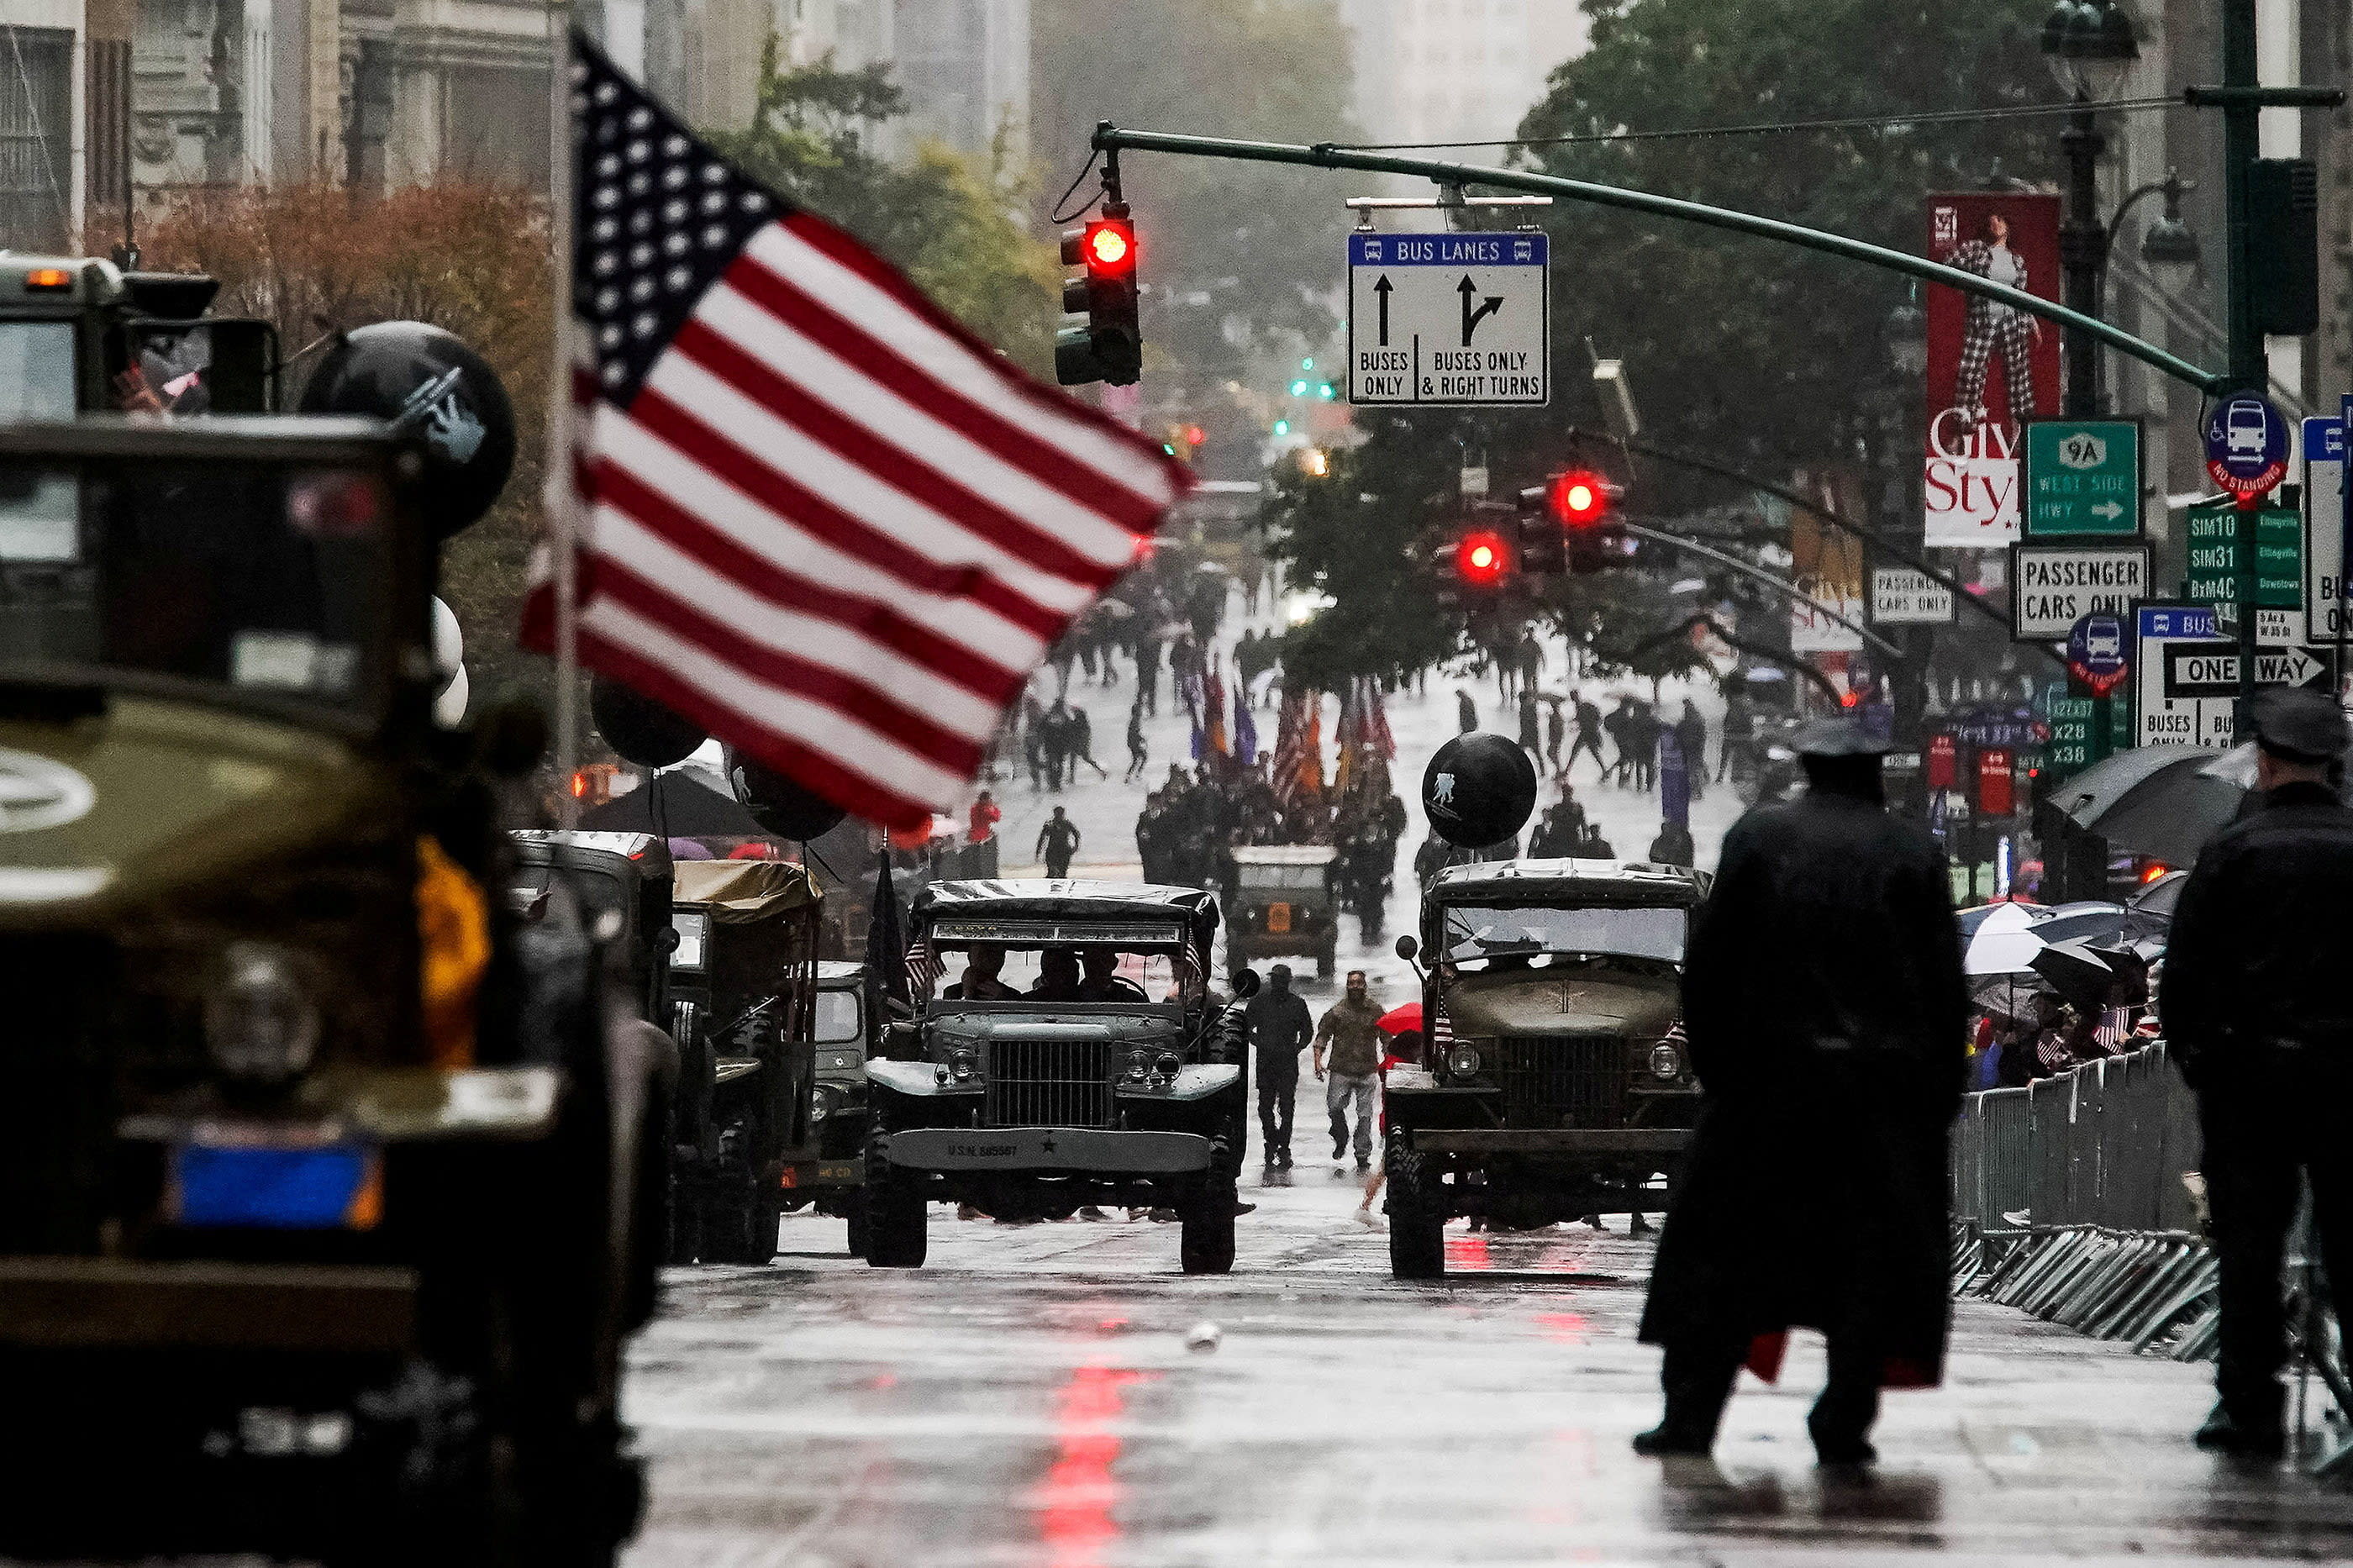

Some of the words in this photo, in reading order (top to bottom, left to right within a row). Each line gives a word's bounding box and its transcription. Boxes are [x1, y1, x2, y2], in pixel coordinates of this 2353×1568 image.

[1398, 242, 1433, 260] BUS
[1442, 242, 1500, 260] LANES
[1361, 352, 1408, 371] BUSES
[1434, 352, 1481, 371] BUSES
[1487, 352, 1527, 371] ONLY
[1365, 376, 1403, 395] ONLY
[1422, 376, 1434, 395] &
[1441, 376, 1487, 395] RIGHT
[1491, 376, 1539, 395] TURNS
[1930, 406, 2021, 462] Giv
[2068, 441, 2098, 461] 9A
[2040, 476, 2080, 492] WEST
[2092, 475, 2124, 492] SIDE
[2214, 463, 2229, 481] NO
[2229, 463, 2281, 492] STANDING
[1926, 460, 2020, 528] Sty
[2039, 502, 2073, 518] HWY
[2191, 514, 2235, 537] SIM10
[2192, 545, 2234, 568] SIM31
[1878, 576, 1947, 590] PASSENGE
[2026, 560, 2130, 587] PASSENGER
[2191, 577, 2235, 598] BxM4C
[1918, 596, 1948, 612] ONLY
[2026, 594, 2077, 619] CARS
[2091, 593, 2131, 615] ONL
[2183, 616, 2215, 634] BUS
[2188, 658, 2237, 681] ONE
[2259, 657, 2309, 680] WAY
[2148, 715, 2190, 733] BUSES
